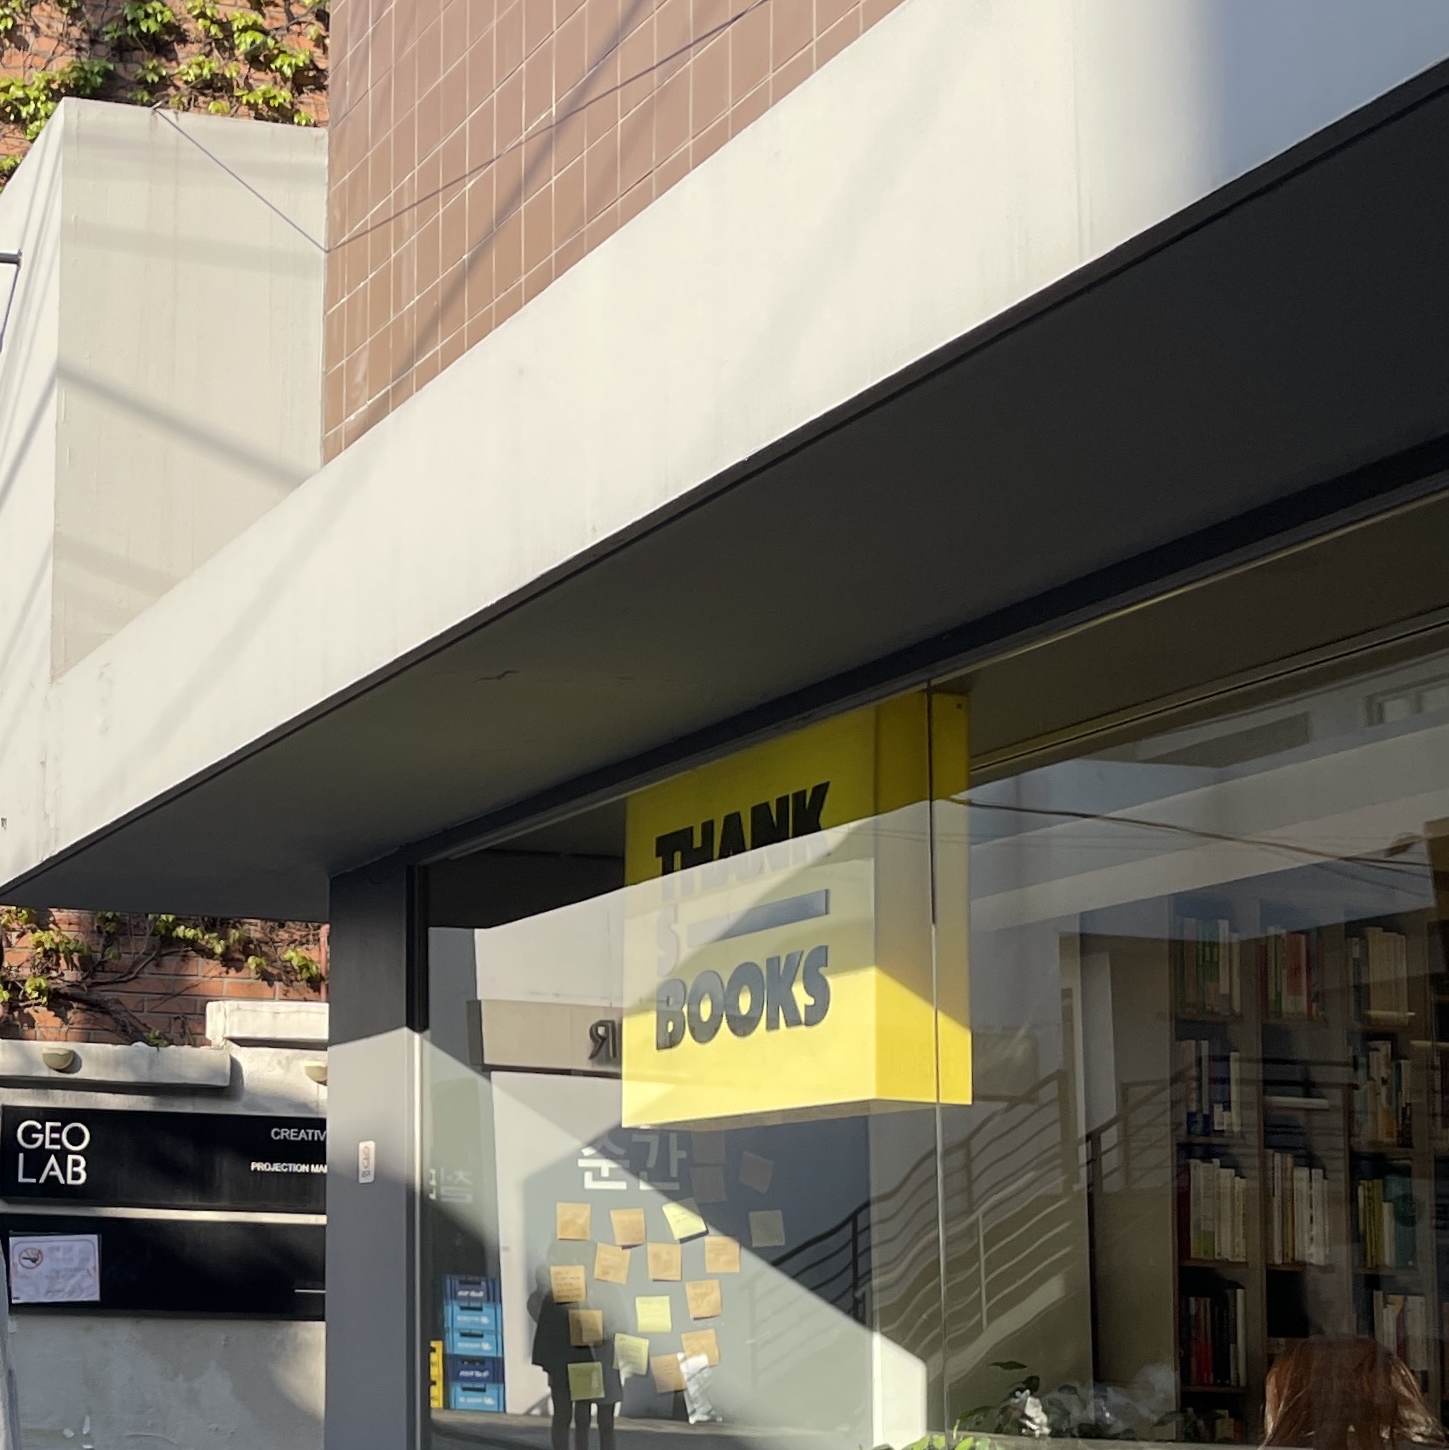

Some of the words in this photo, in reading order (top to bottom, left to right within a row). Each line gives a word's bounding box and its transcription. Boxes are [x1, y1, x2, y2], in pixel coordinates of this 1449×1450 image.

[654, 781, 830, 905] THANK
[655, 945, 831, 1051] BOOKS
[16, 1119, 91, 1151] GEO
[17, 1153, 87, 1186] LAB
[251, 1161, 309, 1173] PROJECTION
